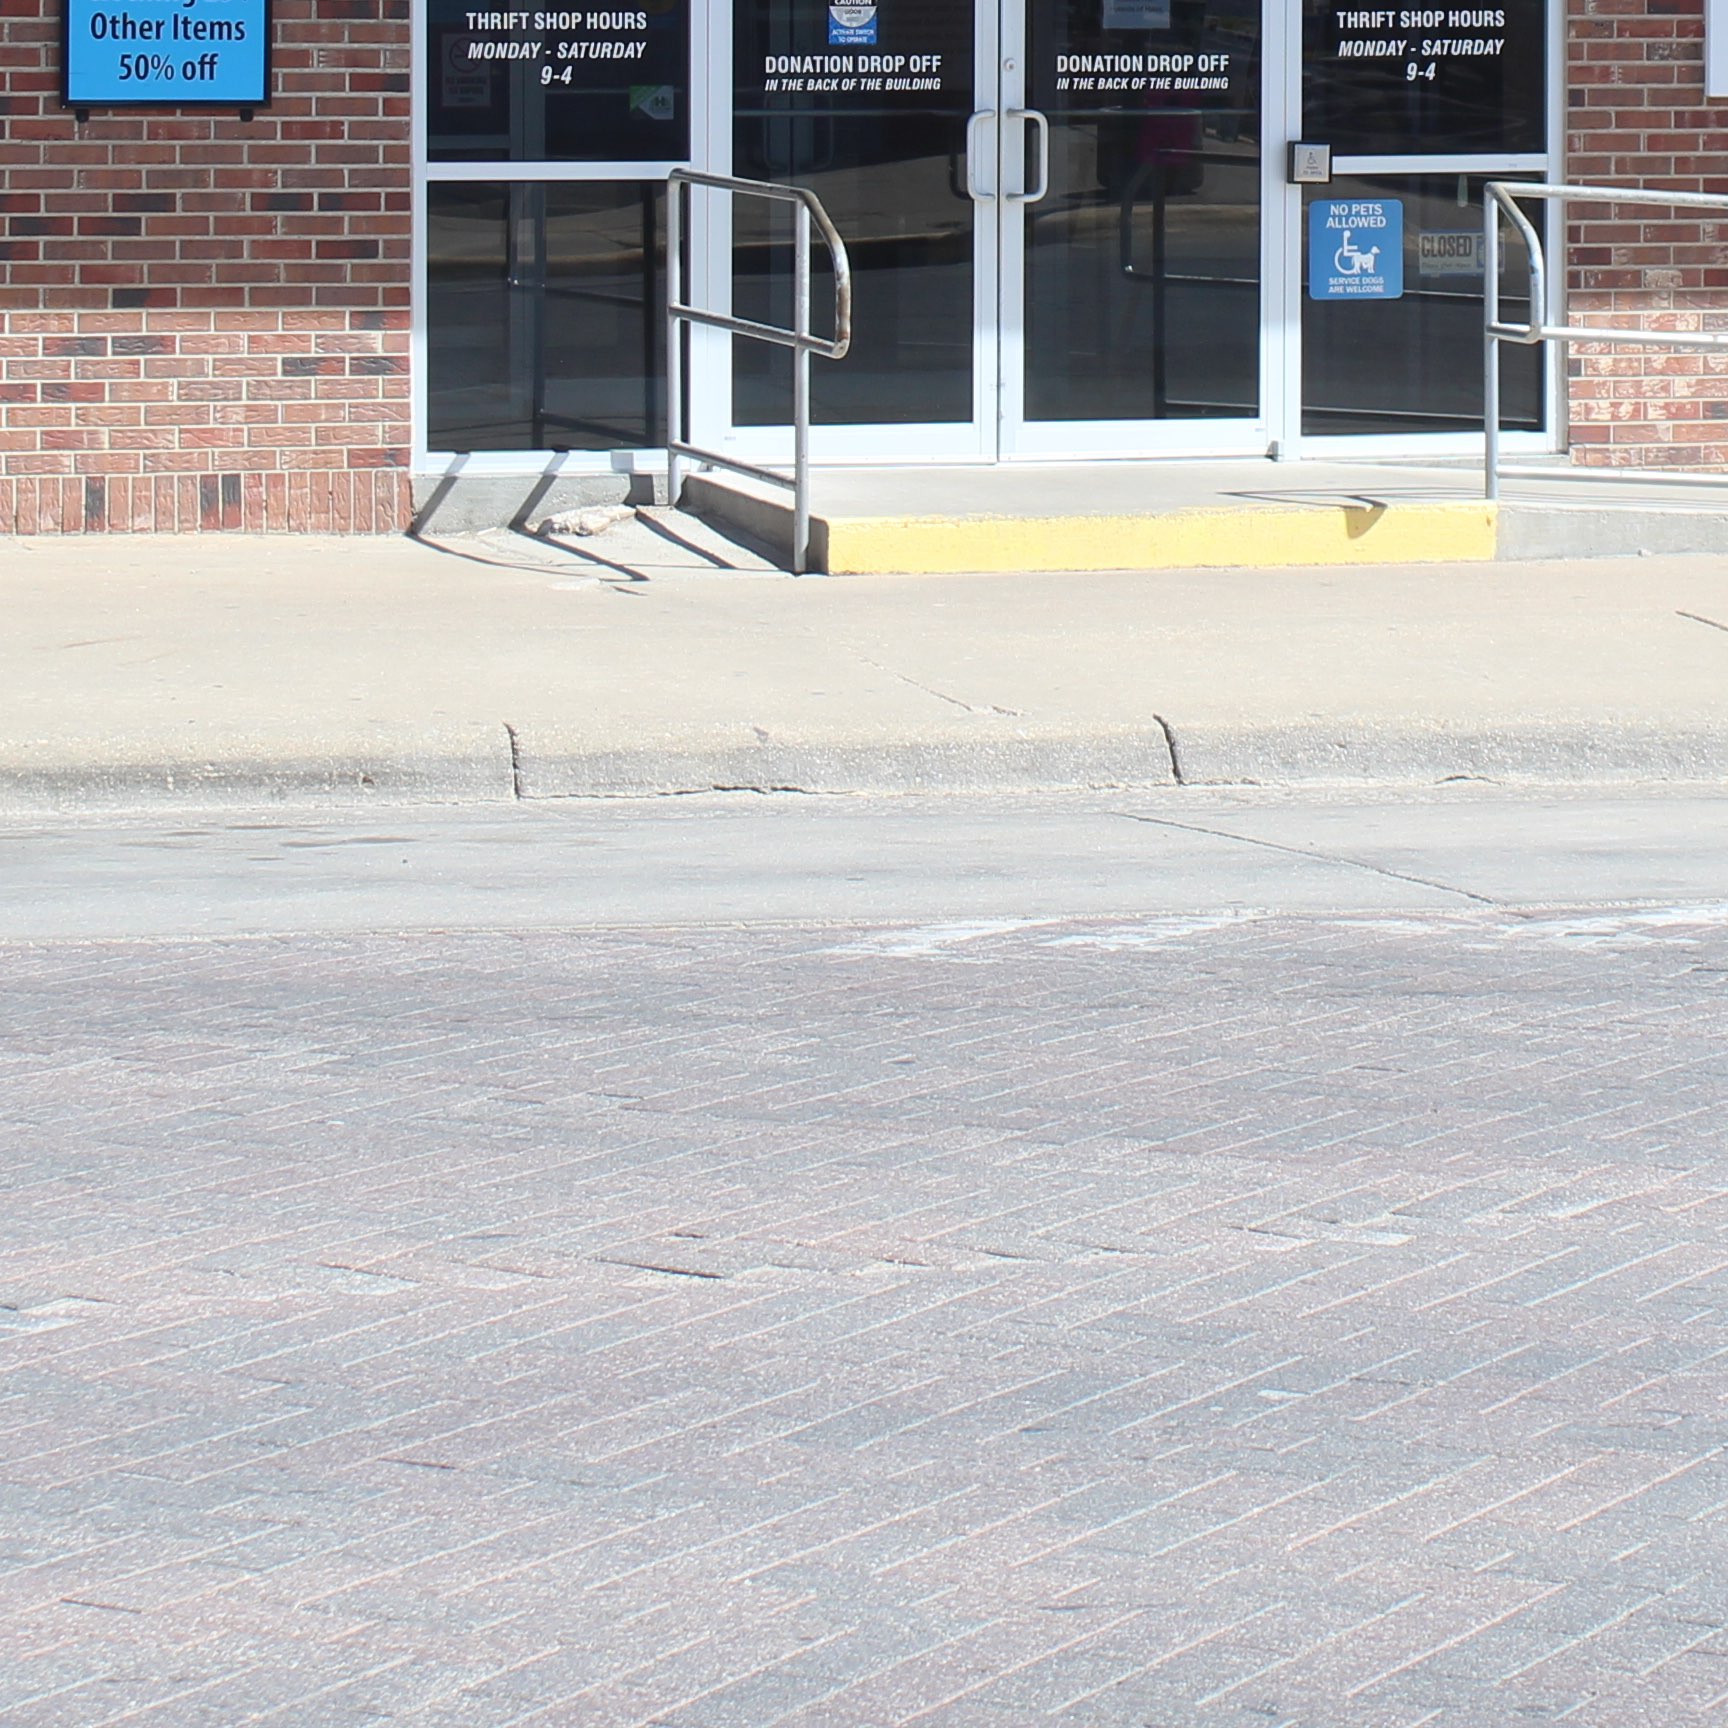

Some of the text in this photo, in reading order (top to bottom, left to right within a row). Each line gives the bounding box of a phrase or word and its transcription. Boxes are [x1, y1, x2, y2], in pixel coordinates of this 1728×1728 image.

[90, 12, 246, 41] Other Items
[466, 12, 647, 30] THRIFT SHOP HOURS
[1336, 10, 1505, 29] THRIFT SHOP HOURS
[468, 42, 542, 59] MONDAY
[557, 42, 647, 59] SATURDAY
[1338, 40, 1407, 57] MONDAY
[1421, 39, 1505, 56] SATURDAY
[118, 53, 219, 81] 50% off
[765, 55, 942, 73] DONATION DROP OFF
[1057, 55, 1229, 72] DONATION DROP OFF
[1406, 62, 1436, 81] 9-4
[540, 66, 573, 85] 9-4
[765, 78, 941, 91] IN THE BACK OF THE BUILDING
[1057, 78, 1229, 90] IN THE BACK OF THE BUILDING
[1330, 204, 1383, 216] NO PETS
[1326, 217, 1387, 229] ALLOWED
[1422, 236, 1472, 258] CLOSED
[1328, 277, 1384, 286] SERVICE DOGS
[1328, 285, 1385, 294] ARE WELCOME
